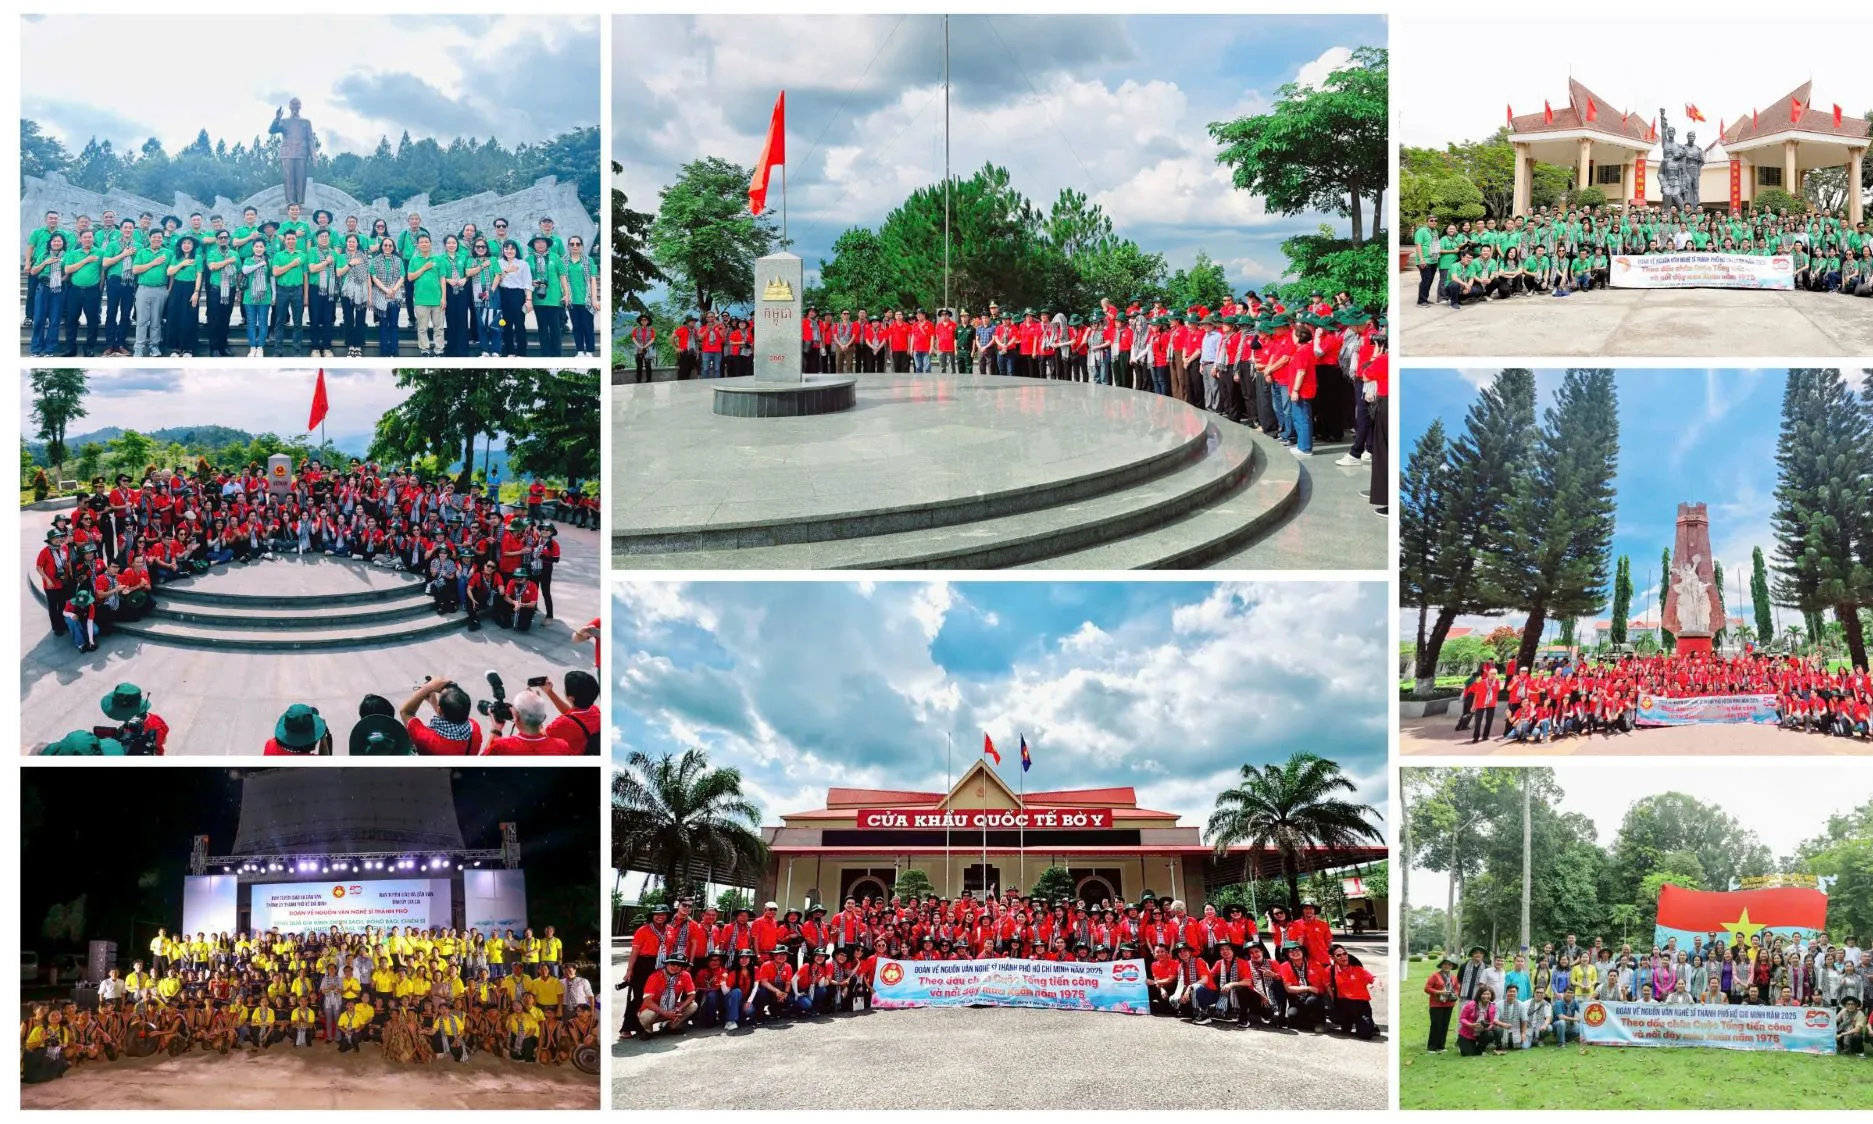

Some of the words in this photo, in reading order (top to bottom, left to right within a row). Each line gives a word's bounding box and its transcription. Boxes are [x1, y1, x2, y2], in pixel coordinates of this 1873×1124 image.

[867, 810, 909, 827] CỬA
[914, 809, 968, 827] KHẨU
[973, 809, 1029, 828] QUỐC
[1034, 809, 1056, 826] TẾ
[1062, 811, 1088, 826] BỜ
[1092, 814, 1105, 826] Y
[914, 966, 930, 974] ĐOÀN
[1042, 964, 1052, 973] CHÍ
[918, 976, 943, 986] Theo
[1049, 976, 1070, 986] tiến
[1072, 977, 1098, 988] công
[930, 988, 942, 997] và
[944, 986, 960, 997] nổi
[1035, 988, 1056, 998] năm
[1060, 990, 1085, 998] 1975
[1781, 1012, 1796, 1020] 2025
[1620, 1018, 1644, 1027] Theo
[1746, 1020, 1765, 1031] tiến
[1768, 1022, 1793, 1034] công
[1632, 1030, 1644, 1038] và
[1756, 1034, 1780, 1043] 1975
